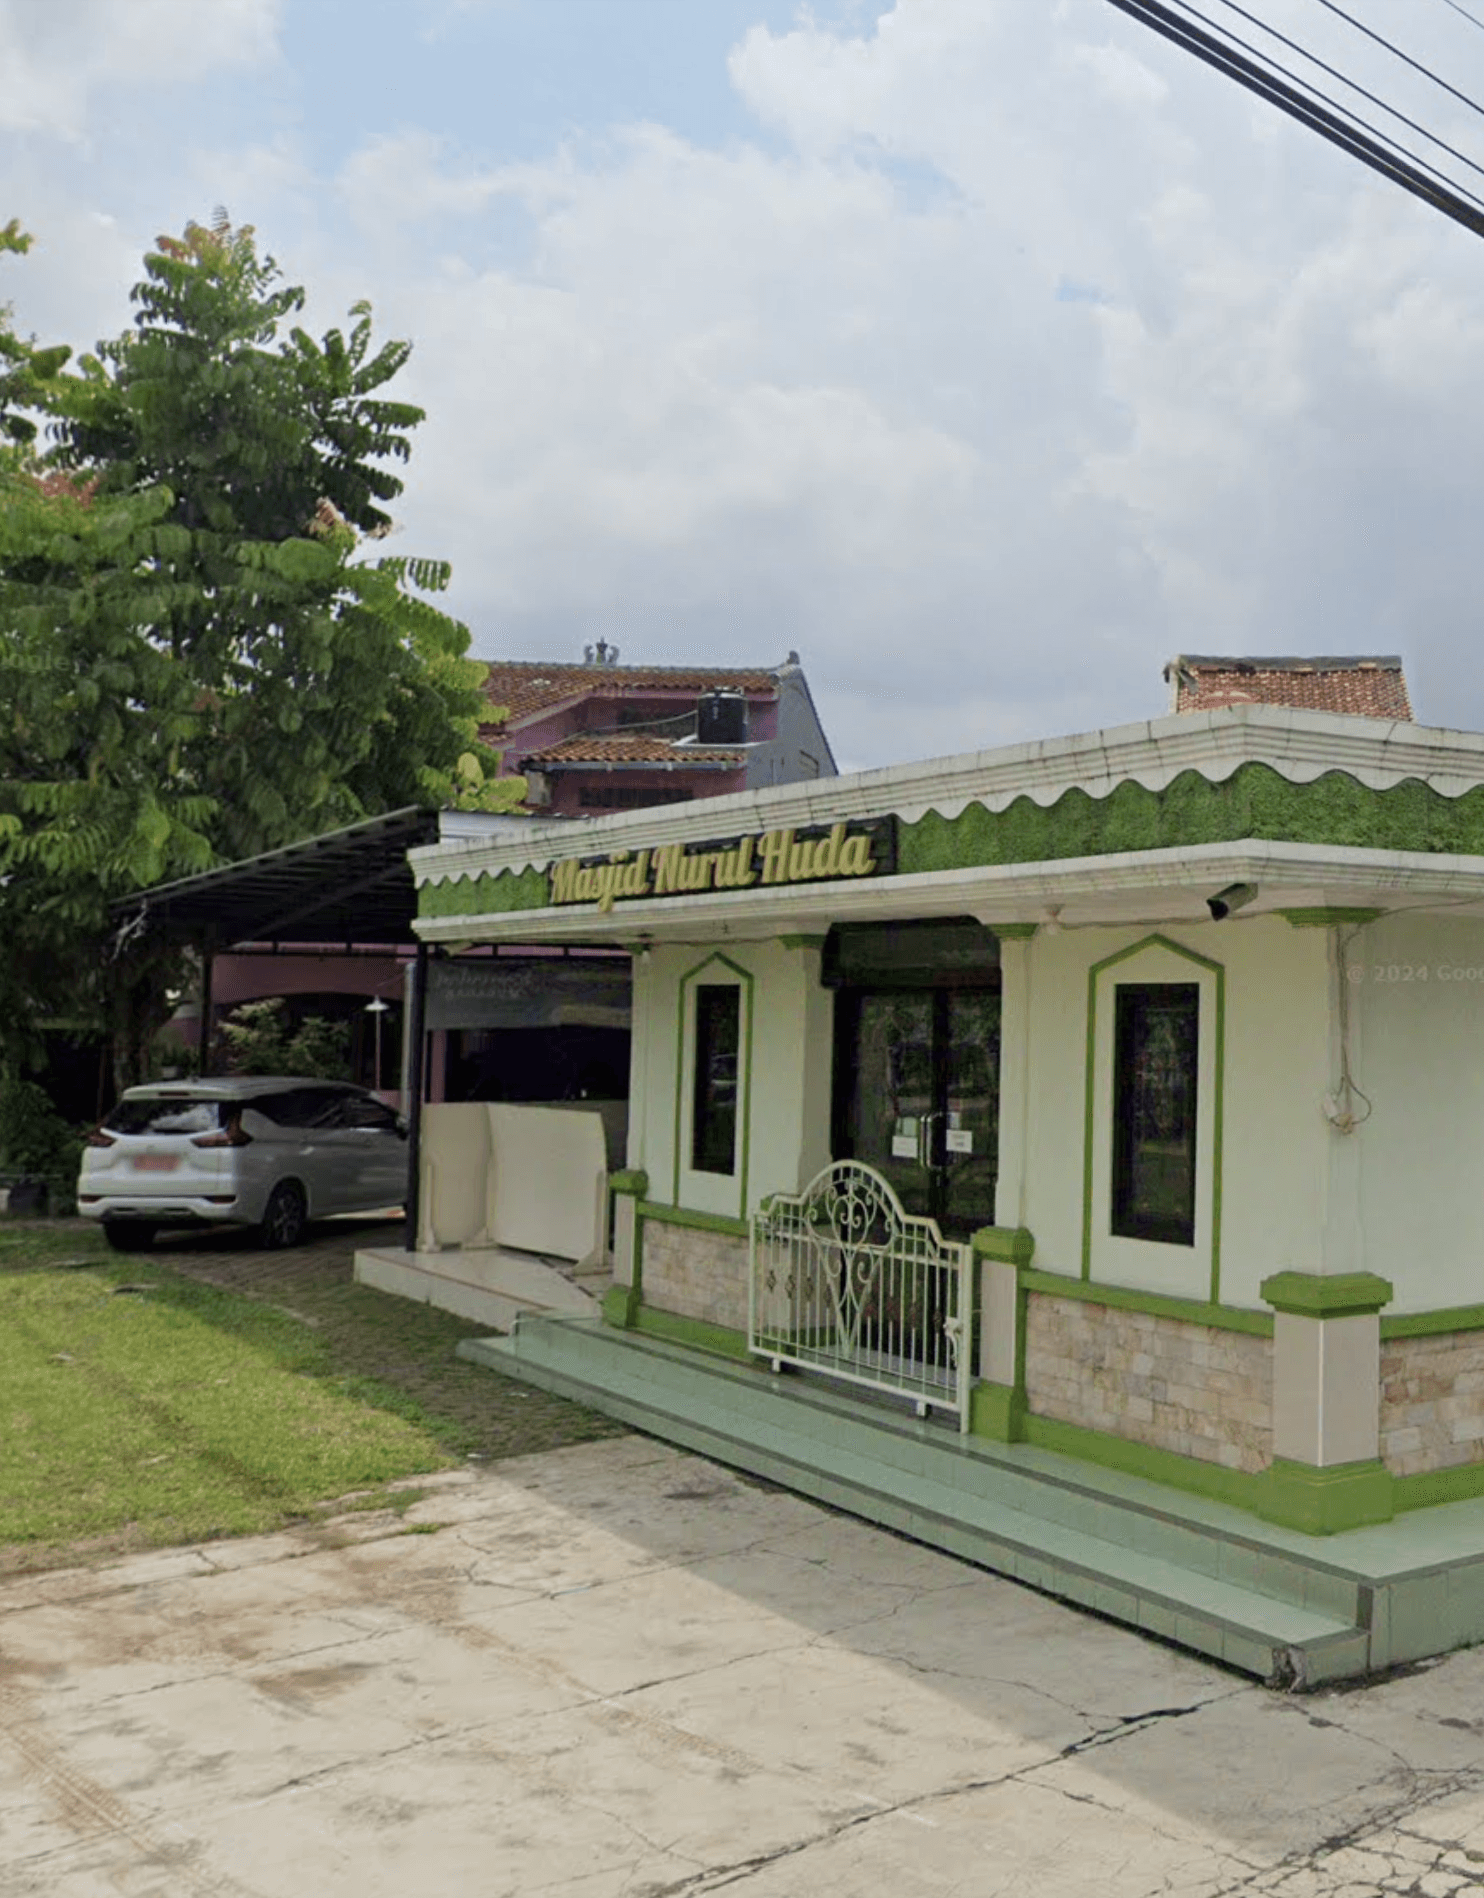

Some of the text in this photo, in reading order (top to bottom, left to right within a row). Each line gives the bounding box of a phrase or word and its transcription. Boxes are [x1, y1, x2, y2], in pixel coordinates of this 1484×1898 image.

[551, 822, 877, 912] Masjid Nurul Huda
